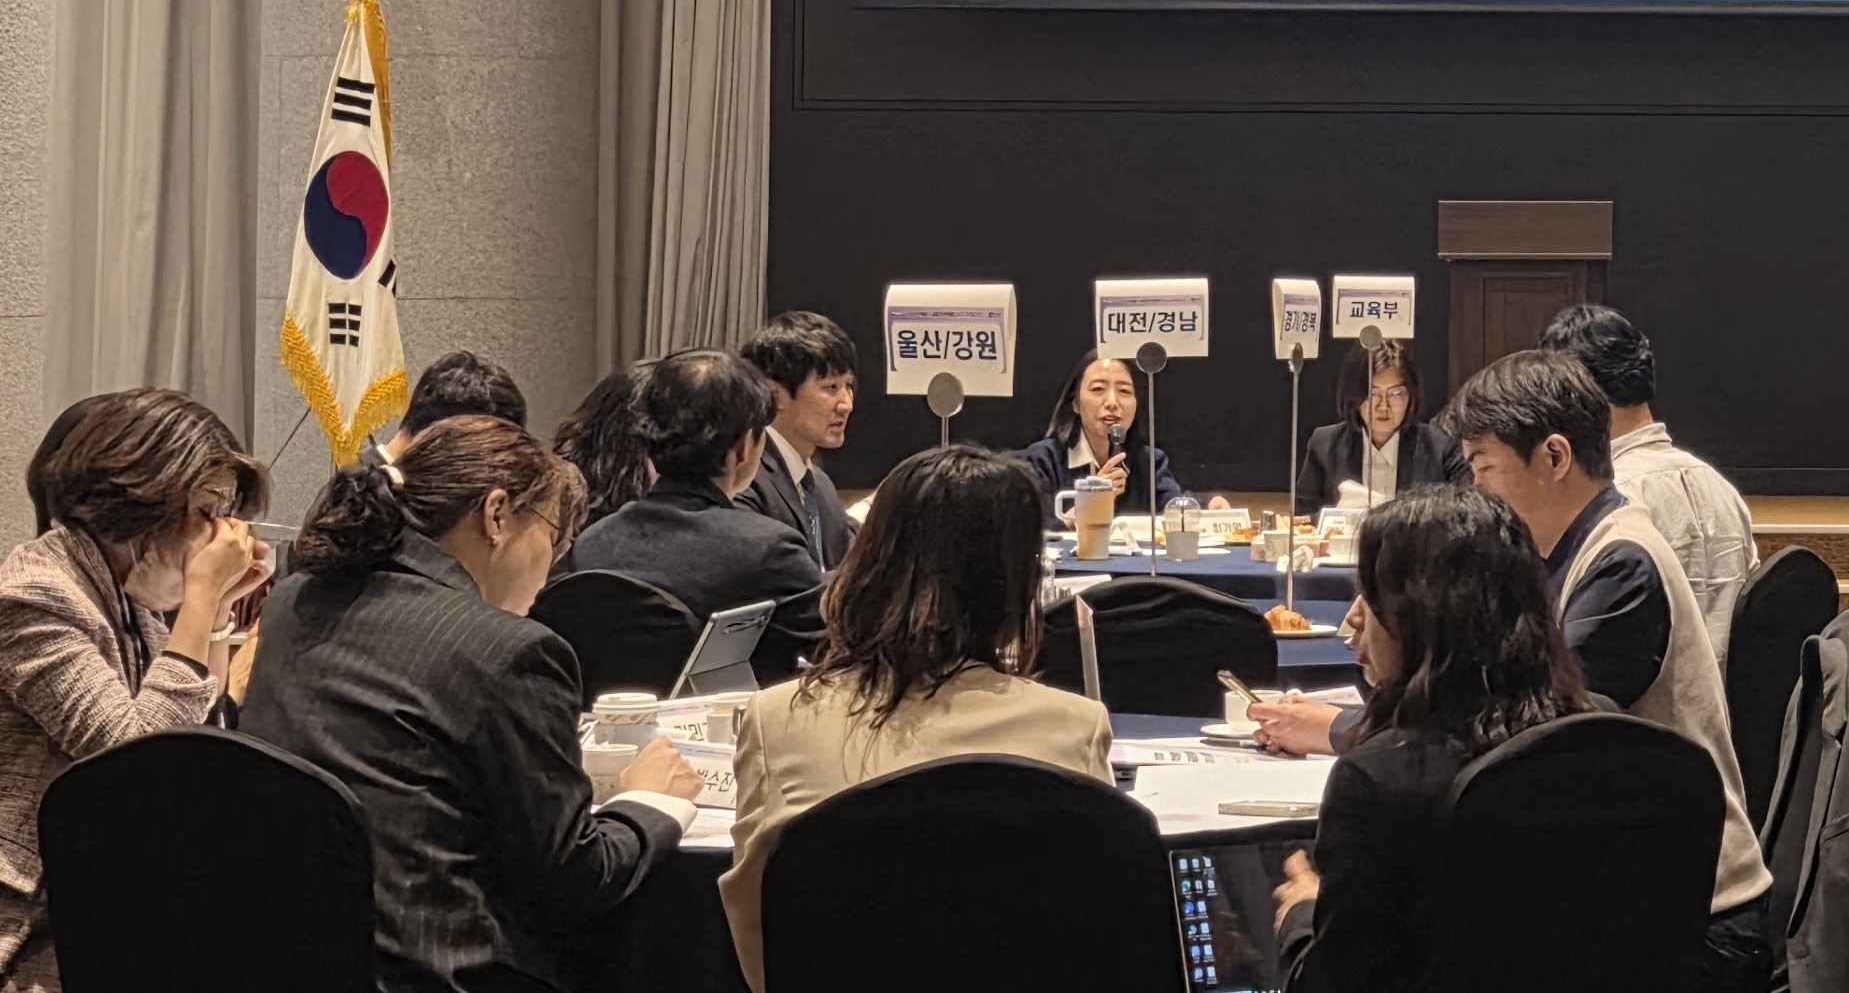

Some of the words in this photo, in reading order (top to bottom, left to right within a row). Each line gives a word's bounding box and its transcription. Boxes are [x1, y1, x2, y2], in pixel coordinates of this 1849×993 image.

[1350, 302, 1397, 319] 교육부
[1109, 311, 1197, 333] 대전/경남
[898, 330, 997, 360] 울산/강원
